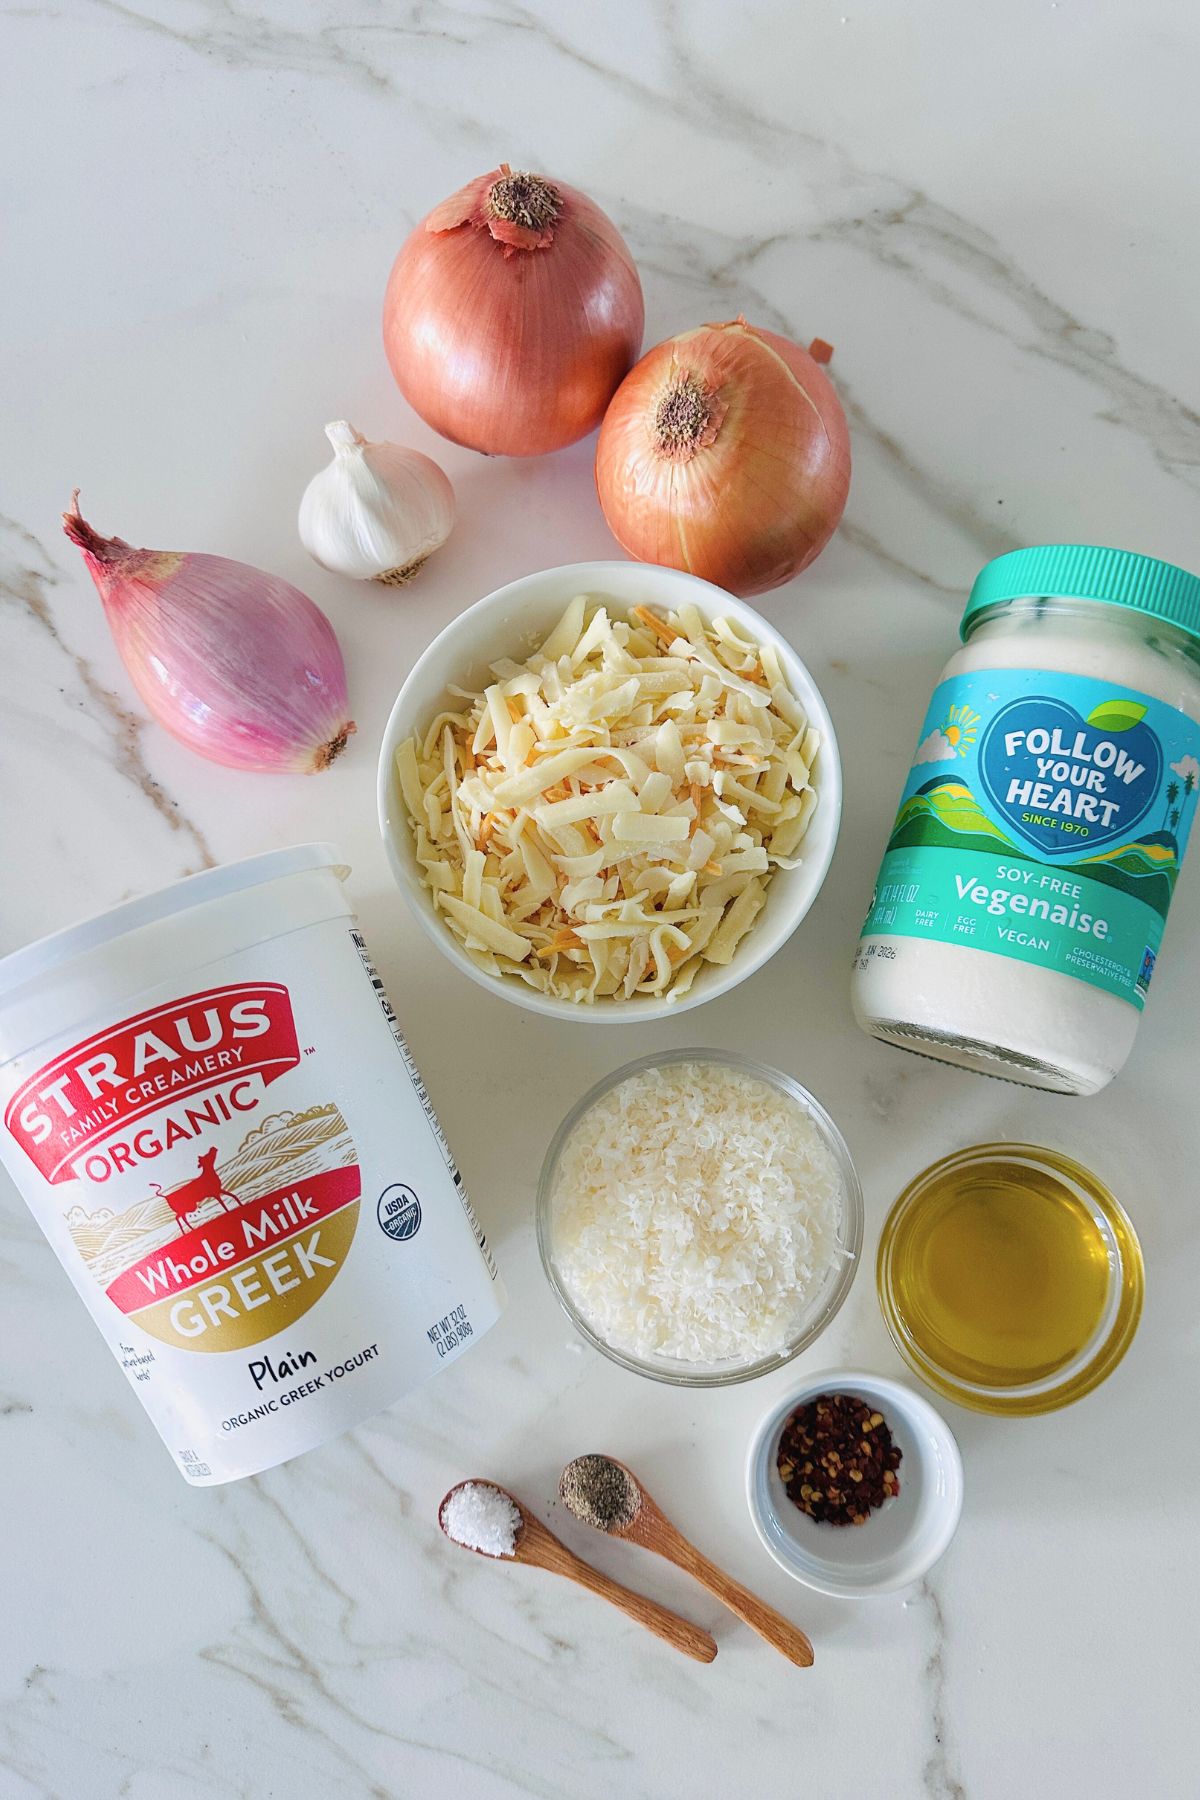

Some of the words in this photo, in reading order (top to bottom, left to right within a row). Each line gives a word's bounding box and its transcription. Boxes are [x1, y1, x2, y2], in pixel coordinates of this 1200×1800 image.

[1004, 727, 1146, 785] FOLLOW
[1036, 757, 1107, 793] YOUR
[1005, 778, 1120, 827] HEART
[1021, 812, 1057, 829] SINCE
[1061, 821, 1089, 837] 1970
[996, 865, 1082, 899] SOY-FREE
[914, 917, 935, 928] FREE
[915, 909, 940, 920] DAIRY
[954, 874, 1109, 940] Vegenaise
[956, 915, 977, 926] EGG
[952, 923, 977, 936] FREE
[996, 926, 1050, 952] VEGAN
[1065, 953, 1121, 981] PRESERVATIVE
[1118, 974, 1132, 988] FREE
[19, 999, 271, 1146] STRAUS
[60, 1097, 119, 1148] FAMILY
[125, 1046, 244, 1105] CREAMERY
[85, 1081, 259, 1183] ORGANIC
[384, 1193, 410, 1216] USDA
[389, 1206, 417, 1231] ORGANIC
[135, 1238, 236, 1295] Whole
[240, 1191, 320, 1249] Milk
[170, 1230, 336, 1338] GREEK
[426, 1323, 442, 1345] NET
[438, 1315, 452, 1335] WT
[456, 1303, 467, 1321] OZ
[436, 1341, 447, 1358] (2
[443, 1330, 459, 1351] LBS)
[456, 1321, 473, 1341] 908g
[221, 1400, 279, 1431] ORGANIC
[279, 1376, 326, 1406] GREEK
[324, 1343, 380, 1383] YOGURT
[247, 1351, 317, 1391] Plain
